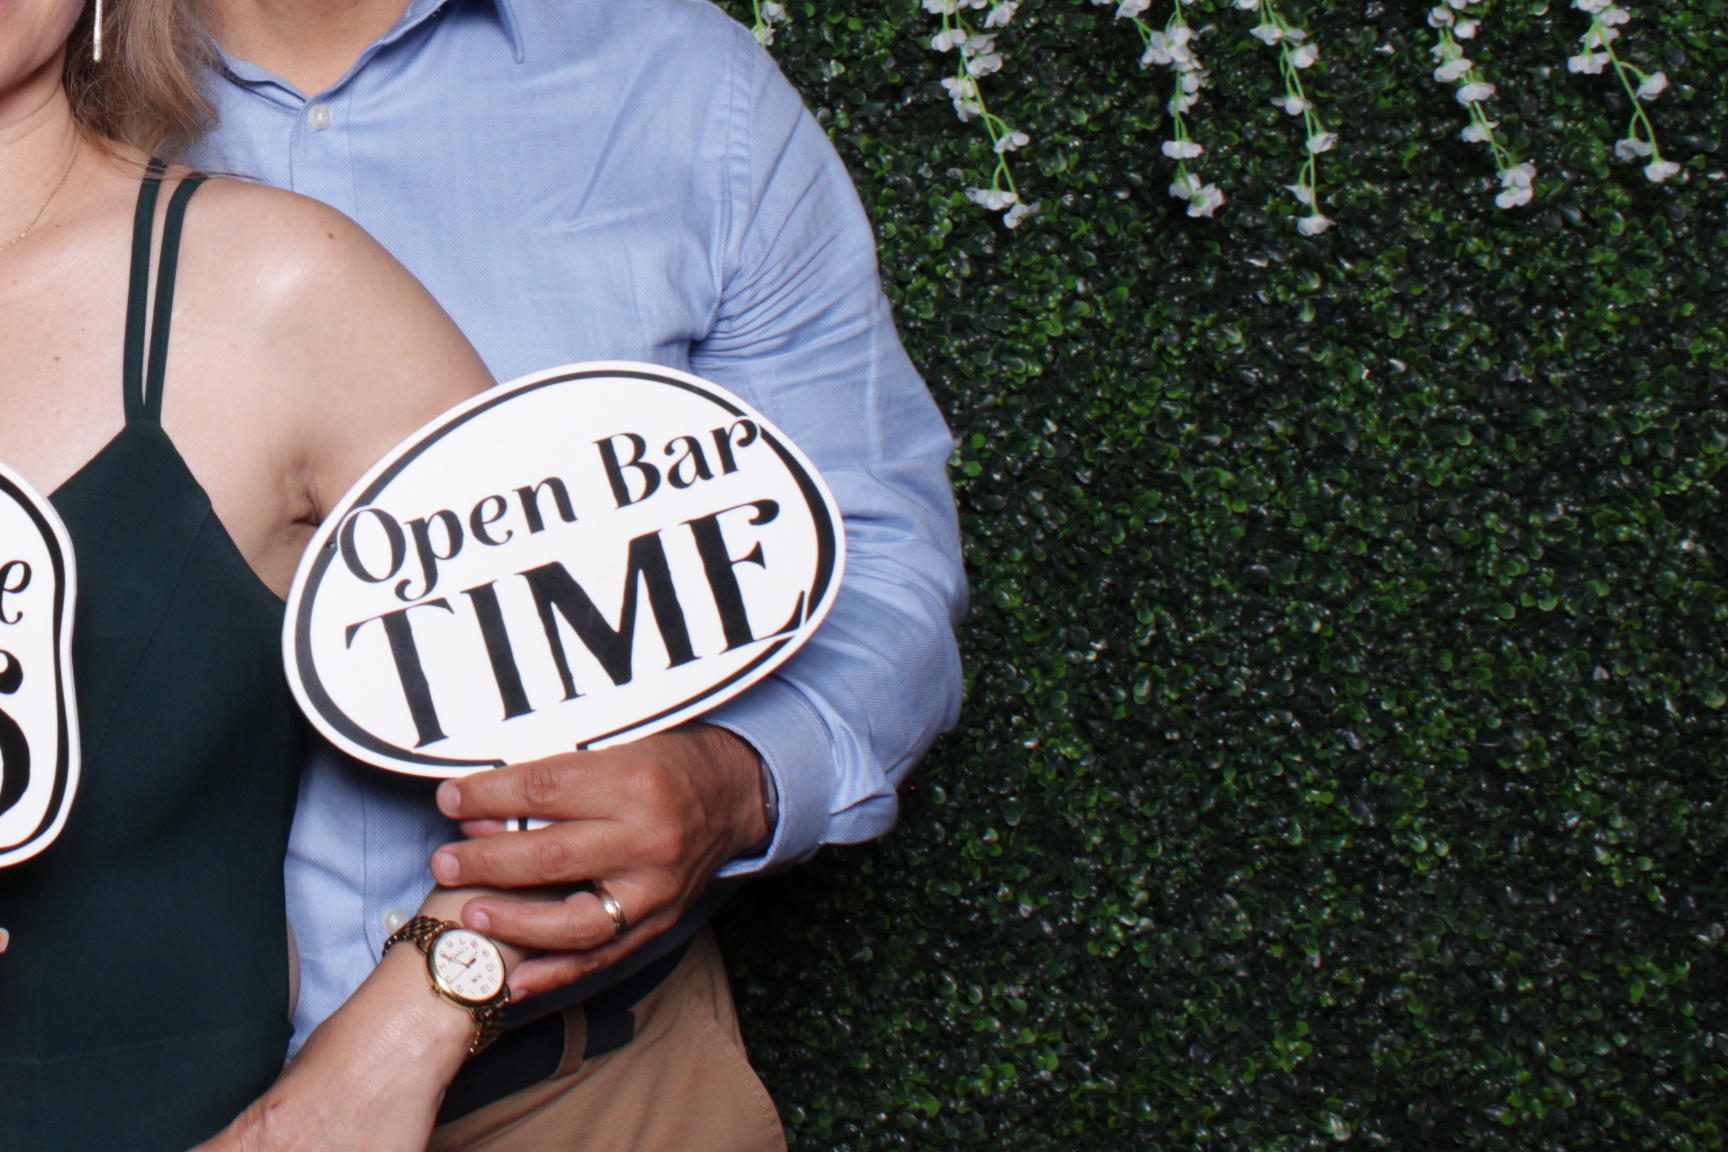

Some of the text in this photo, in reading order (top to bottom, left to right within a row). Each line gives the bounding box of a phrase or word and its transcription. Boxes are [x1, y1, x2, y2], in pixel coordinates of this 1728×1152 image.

[338, 418, 759, 602] Open Bar
[344, 498, 805, 749] TIME
